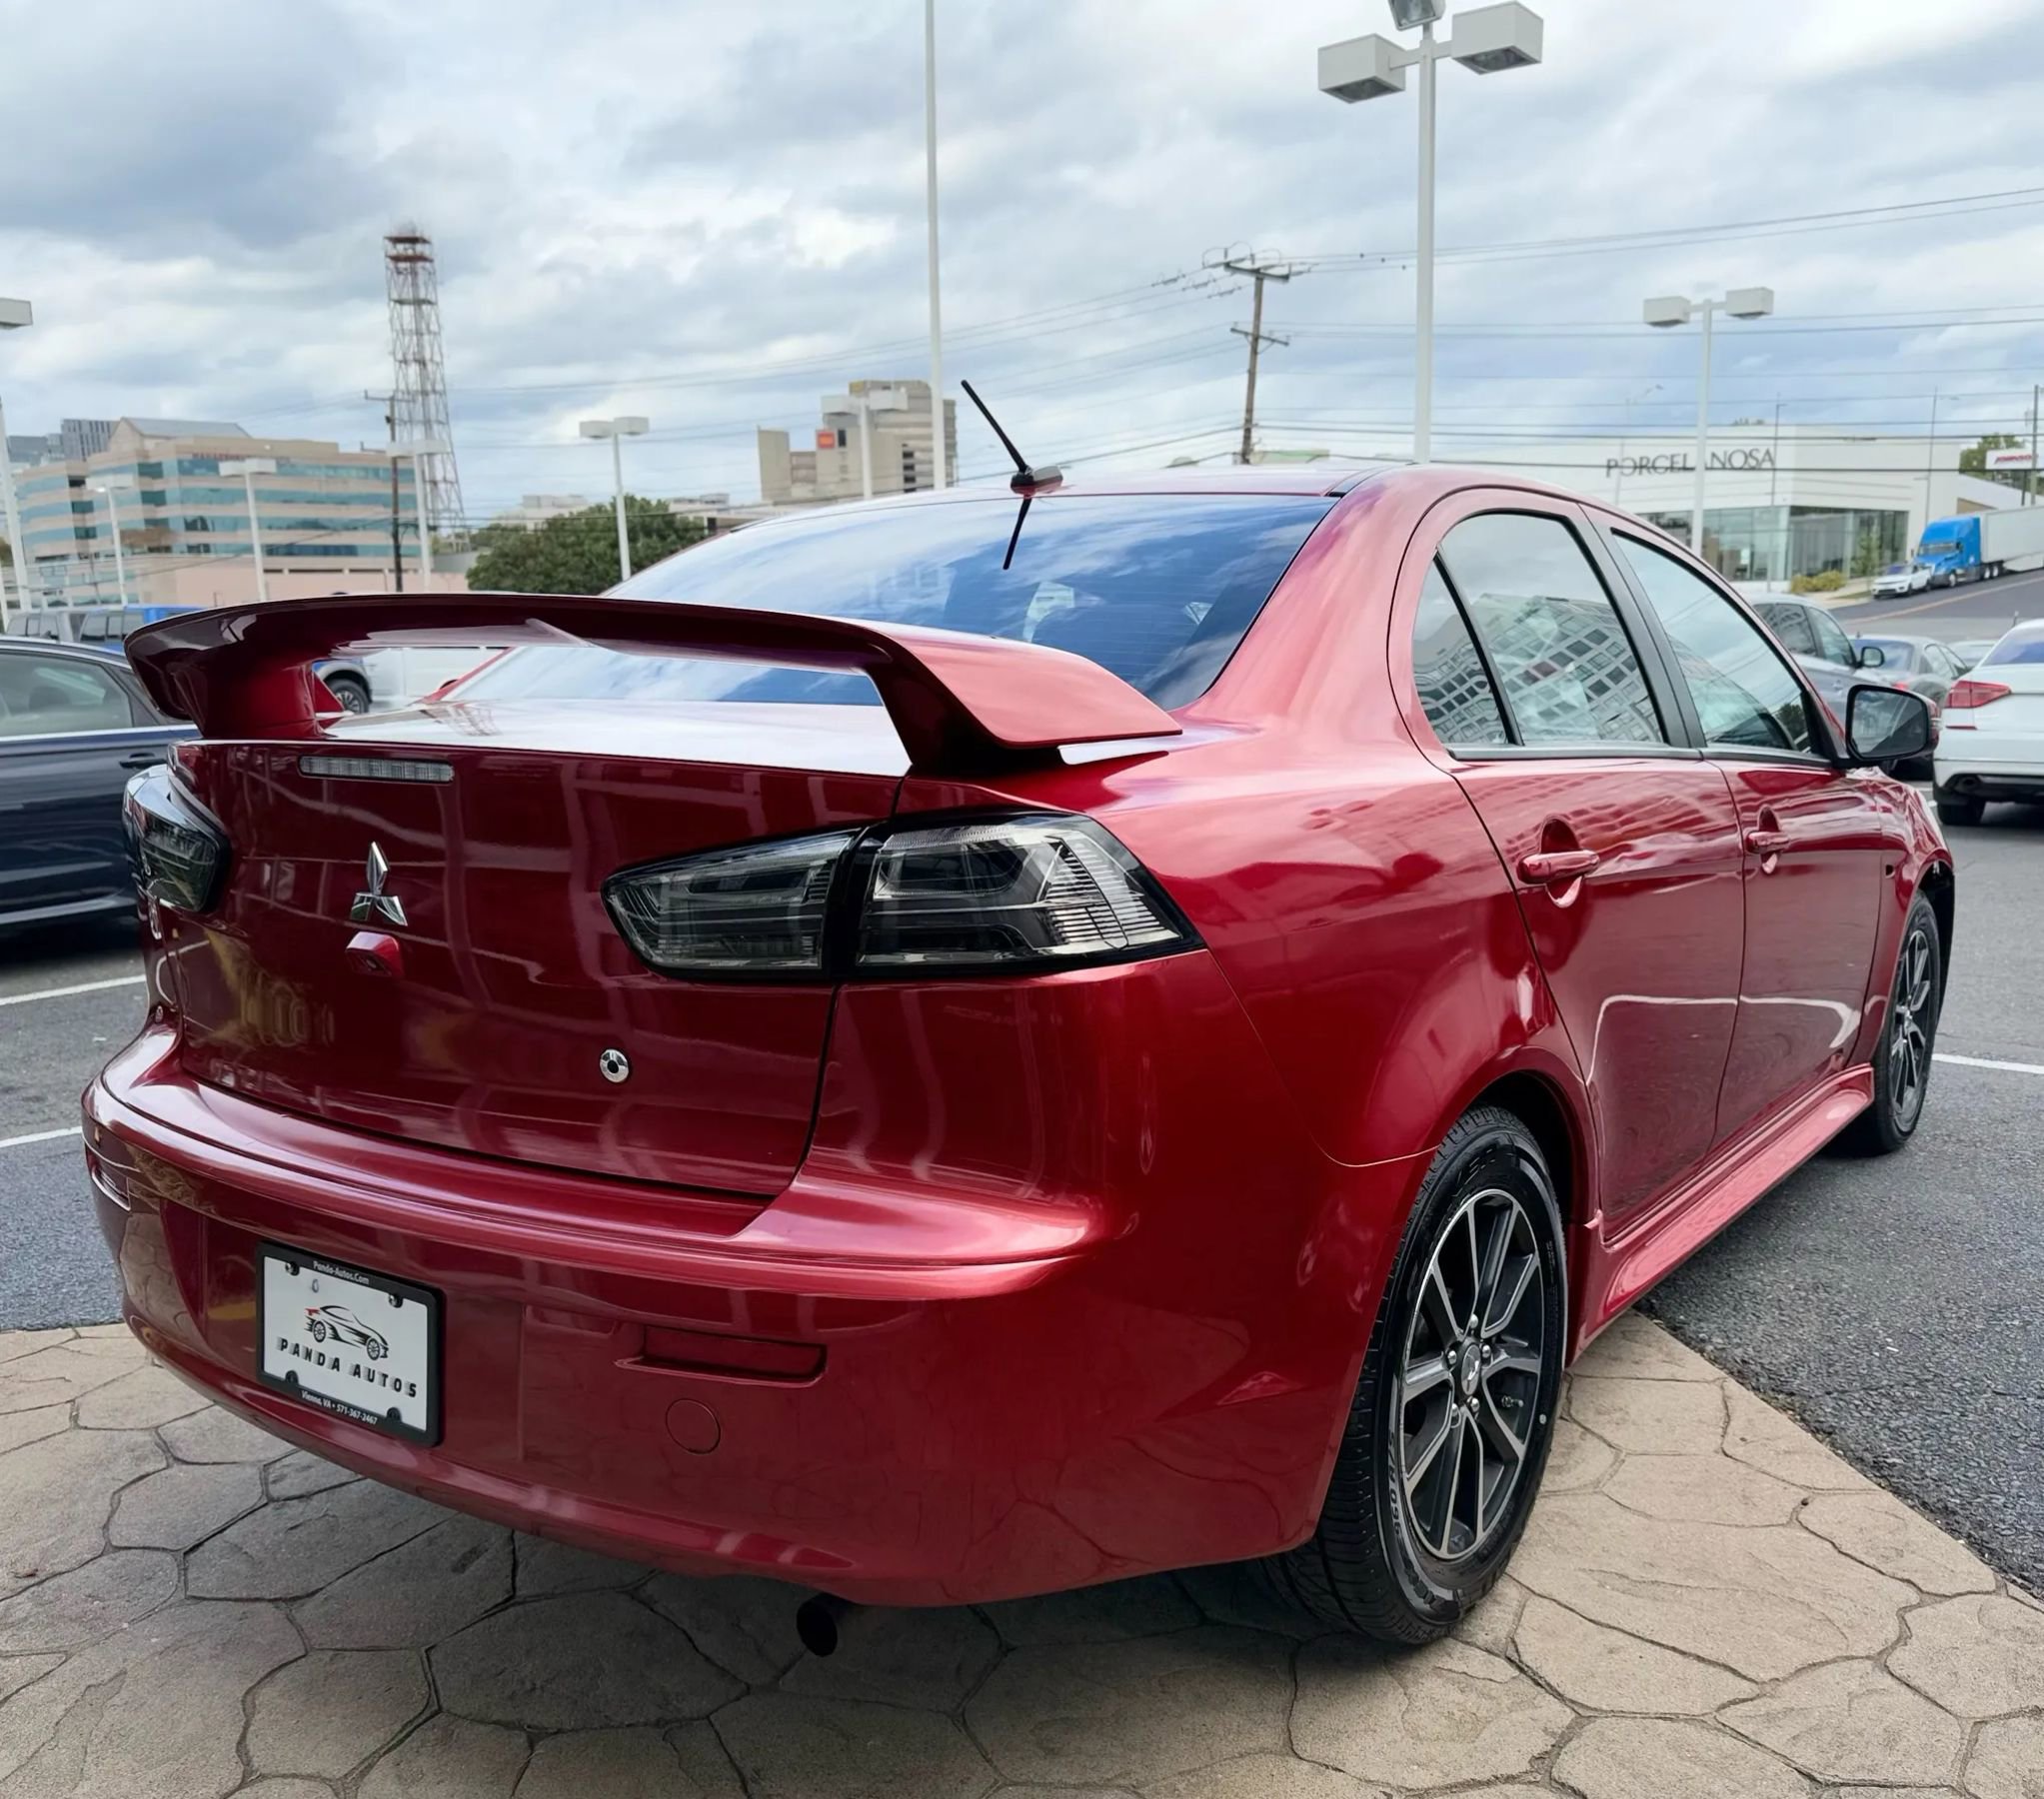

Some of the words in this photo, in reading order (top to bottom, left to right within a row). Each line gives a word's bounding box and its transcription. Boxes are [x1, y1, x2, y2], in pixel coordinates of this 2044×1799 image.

[1606, 449, 1775, 478] PORCELNOSA
[279, 1337, 340, 1372] PANDA
[351, 1363, 417, 1398] AUTOS
